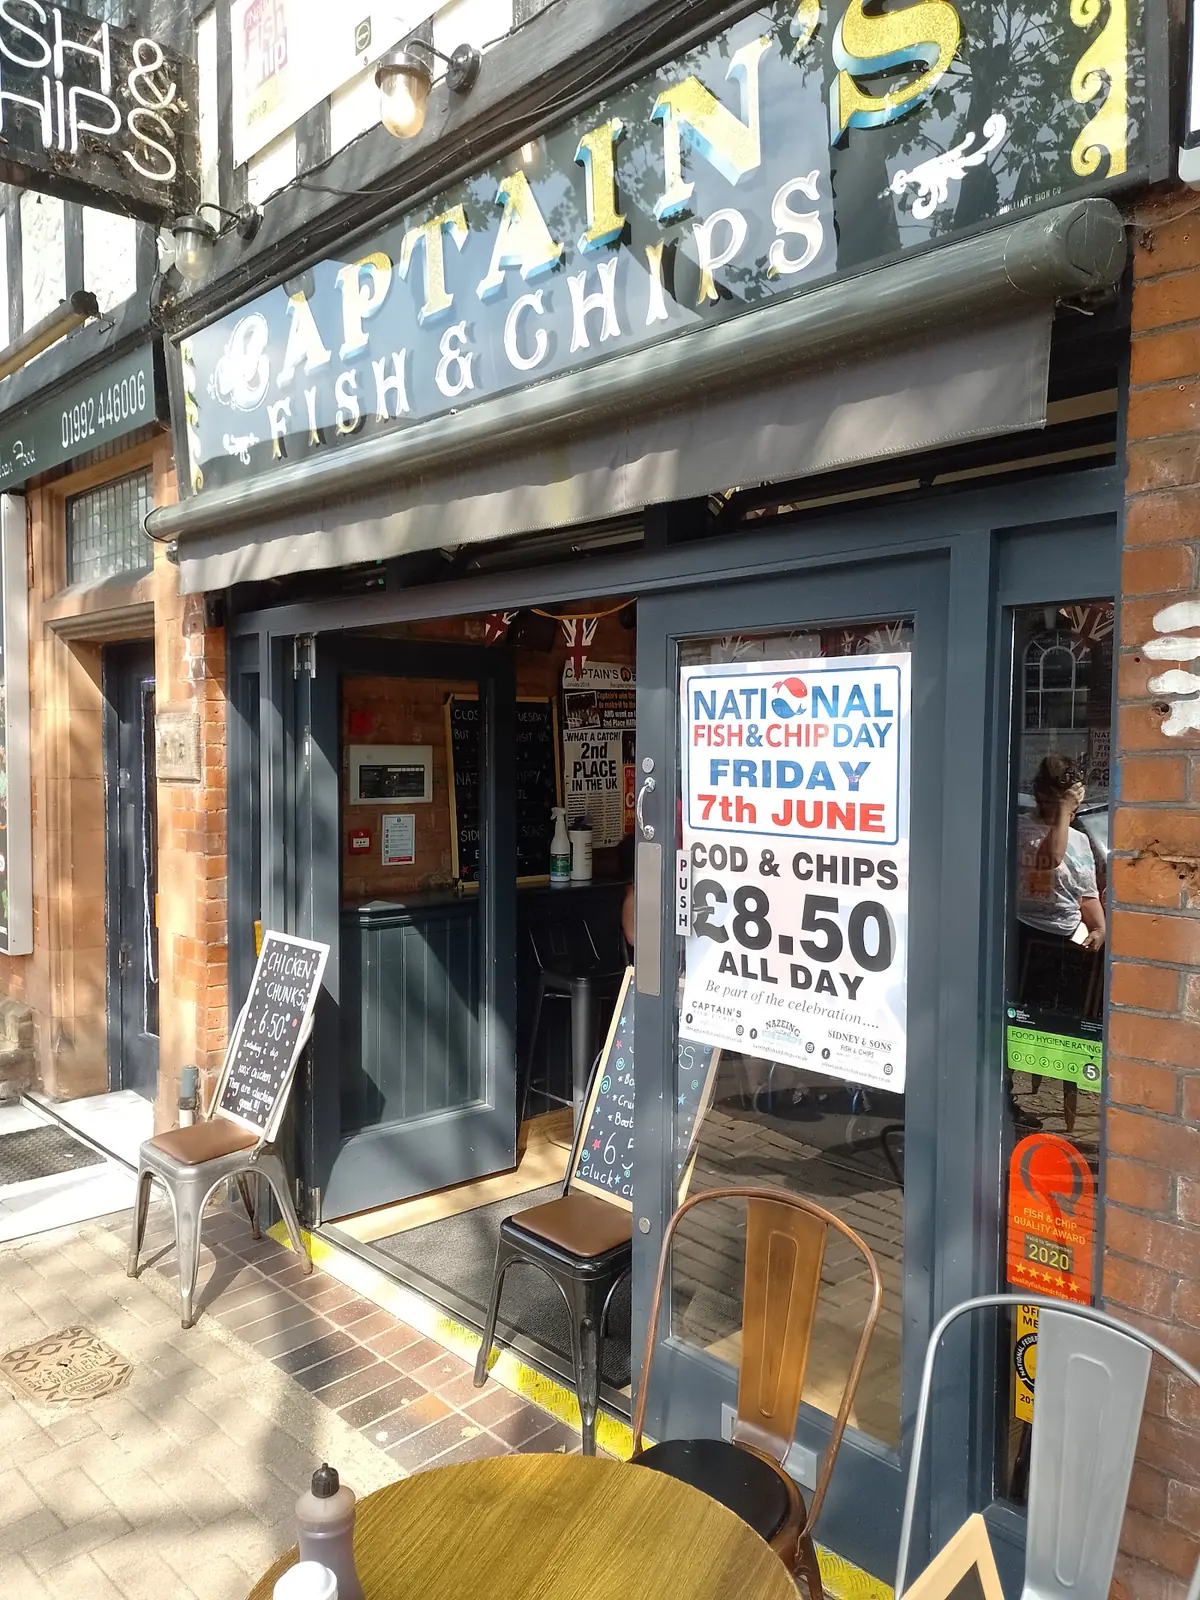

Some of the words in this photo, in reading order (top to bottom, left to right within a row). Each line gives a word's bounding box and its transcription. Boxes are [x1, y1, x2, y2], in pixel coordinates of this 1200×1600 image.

[128, 38, 177, 110] &
[207, 0, 965, 412] CAPTAIN'S
[1034, 189, 1051, 202] SIGN
[267, 347, 410, 460] FISH
[435, 320, 475, 398] &
[503, 169, 825, 371] CHIPS
[61, 397, 96, 449] 01992
[97, 369, 146, 429] 446006
[565, 667, 619, 680] CPTAIN'S
[566, 731, 588, 742] WHAT
[589, 731, 596, 741] A
[597, 731, 621, 741] CATCH!
[581, 742, 608, 760] 2nd
[573, 760, 617, 779] PLACE
[709, 758, 872, 792] FRIDAY
[572, 779, 582, 791] IN
[585, 778, 603, 791] THE
[605, 777, 618, 790] UK
[697, 793, 757, 824] 7th
[771, 798, 886, 833] JUNE
[690, 841, 749, 873] COD
[759, 848, 781, 878] &
[792, 851, 899, 891] CHIPS
[679, 859, 688, 927] PUSH
[692, 878, 898, 973] £8.50
[267, 951, 314, 981] CHICKEN
[717, 950, 779, 985] ALL
[789, 962, 865, 1001] DAY
[266, 981, 306, 1007] CHUNKS
[706, 979, 719, 993] Be
[722, 986, 748, 1001] part
[751, 990, 766, 1005] of
[765, 992, 785, 1008] the
[692, 1000, 742, 1018] CAPTAIN'S
[765, 1018, 801, 1038] NAZEING
[827, 1029, 860, 1045] SIDNEY
[861, 1037, 867, 1046] &
[869, 1039, 892, 1052] SONS
[840, 1044, 852, 1053] FISH
[858, 1048, 875, 1059] CHIPS
[1011, 1030, 1035, 1041] FOOD
[1036, 1035, 1070, 1048] HYGIENE
[1071, 1041, 1101, 1054] RATING
[269, 1048, 279, 1061] dip
[250, 1063, 273, 1086] Chicken
[1086, 1064, 1096, 1079] 5
[228, 1076, 242, 1098] They
[240, 1082, 252, 1096] are
[1013, 1215, 1051, 1234] QUALITY
[1052, 1228, 1086, 1245] AWARD
[1023, 1207, 1044, 1220] FISH
[1046, 1214, 1053, 1223] &
[1055, 1217, 1078, 1230] CHIP
[1028, 1243, 1070, 1271] 2020
[1045, 1240, 1073, 1253] September
[1015, 1346, 1026, 1377] NATIONAL
